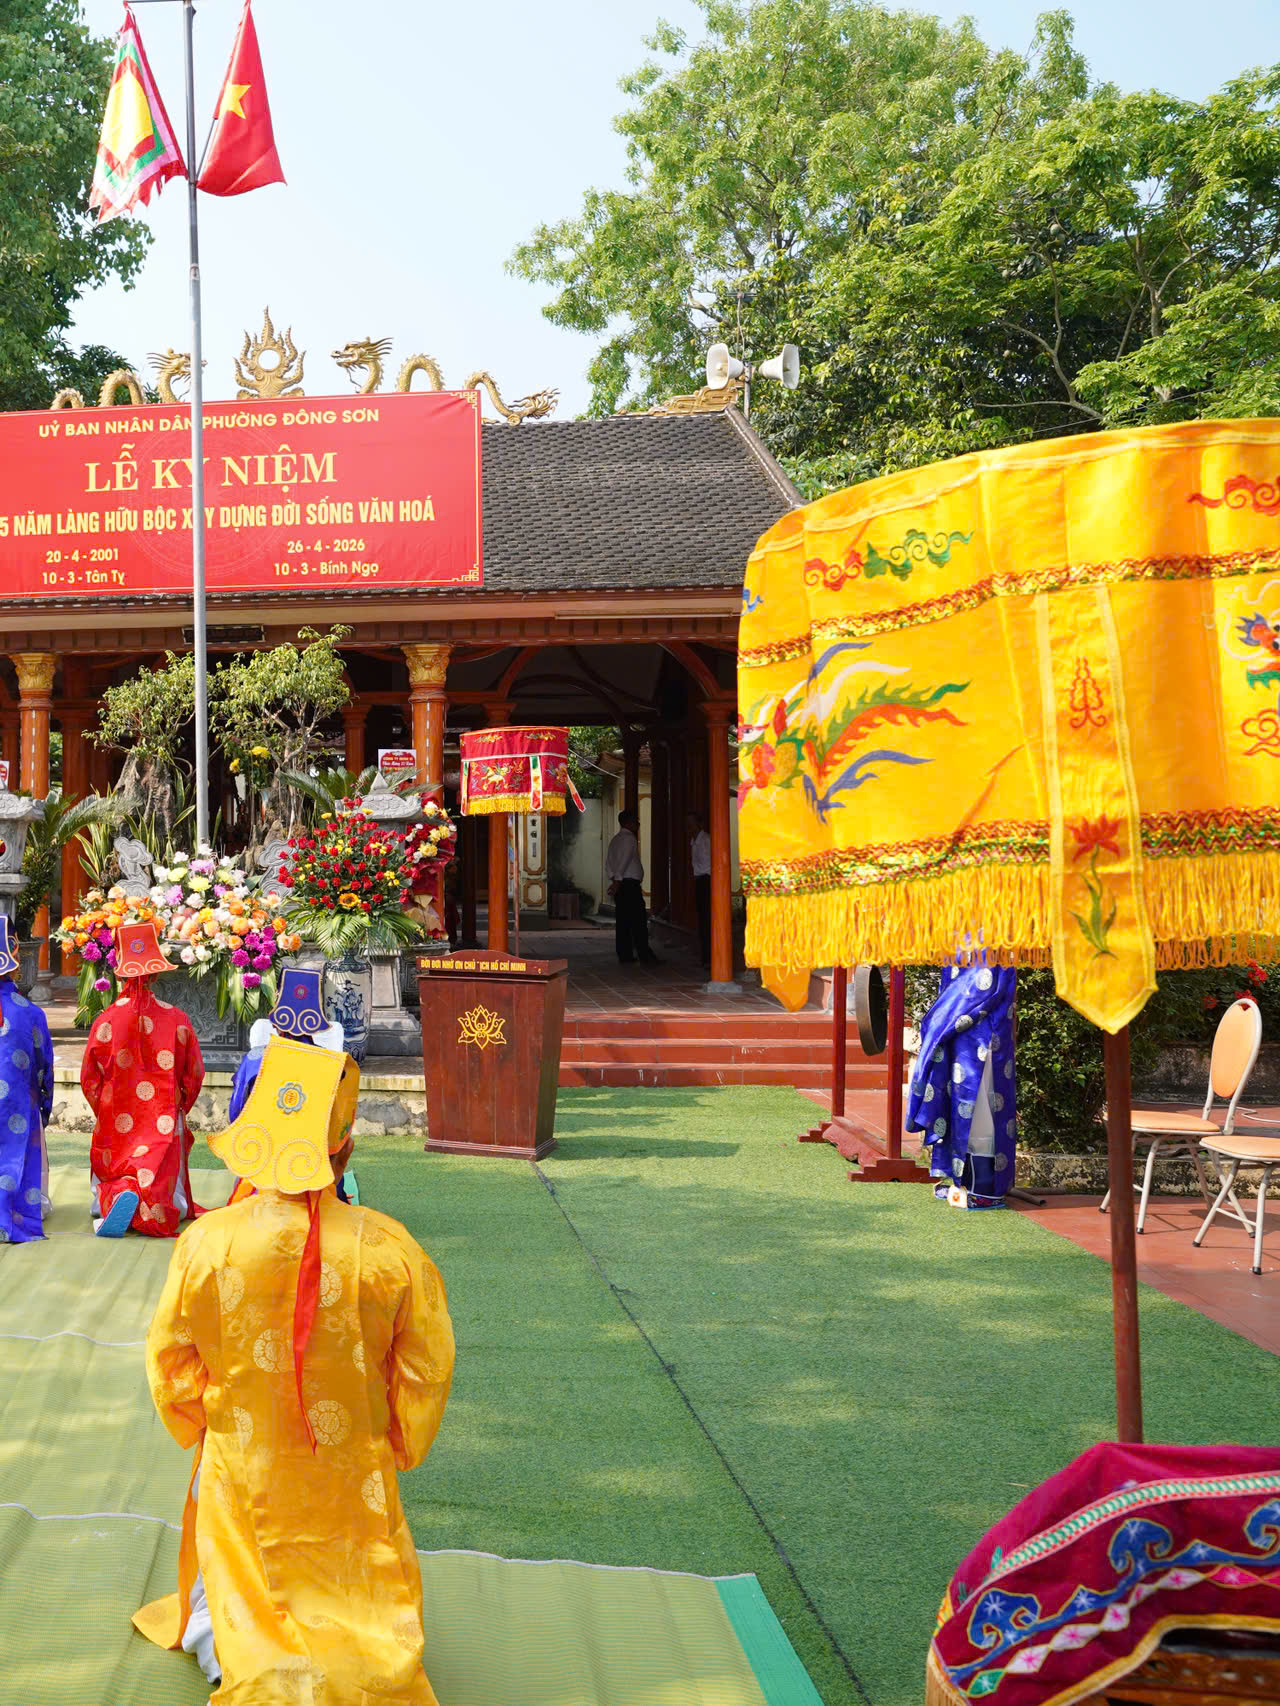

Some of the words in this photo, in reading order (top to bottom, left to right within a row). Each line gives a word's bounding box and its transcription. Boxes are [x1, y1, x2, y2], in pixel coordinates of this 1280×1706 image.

[38, 420, 60, 438] UỶ
[65, 422, 100, 437] BAN
[104, 416, 154, 435] NHÂN
[159, 414, 193, 432] DÂN
[202, 410, 278, 430] PHƯỜNG
[281, 408, 337, 427] ĐÔNG
[341, 408, 380, 424] SƠN
[84, 442, 139, 493] LỄ
[220, 443, 338, 494] NIỆM
[13, 510, 52, 537] NĂM
[56, 508, 100, 535] LÀNG
[104, 506, 139, 533] HỮU
[142, 505, 177, 536] BỘC
[181, 506, 215, 530] XY
[219, 503, 267, 533] DỰNG
[270, 498, 301, 527] ĐỜI
[305, 495, 354, 526] SỐNG
[358, 496, 395, 524] VĂN
[399, 494, 436, 523] HOÁ
[287, 539, 304, 554] 26
[333, 538, 366, 553] 2026
[45, 550, 62, 564] 20
[89, 547, 119, 562] 2001
[42, 571, 57, 585] 10
[85, 569, 108, 584] Tân
[274, 562, 290, 576] 10
[319, 560, 348, 575] Bính
[351, 560, 379, 577] Ngọ
[477, 960, 490, 972] ỊCH
